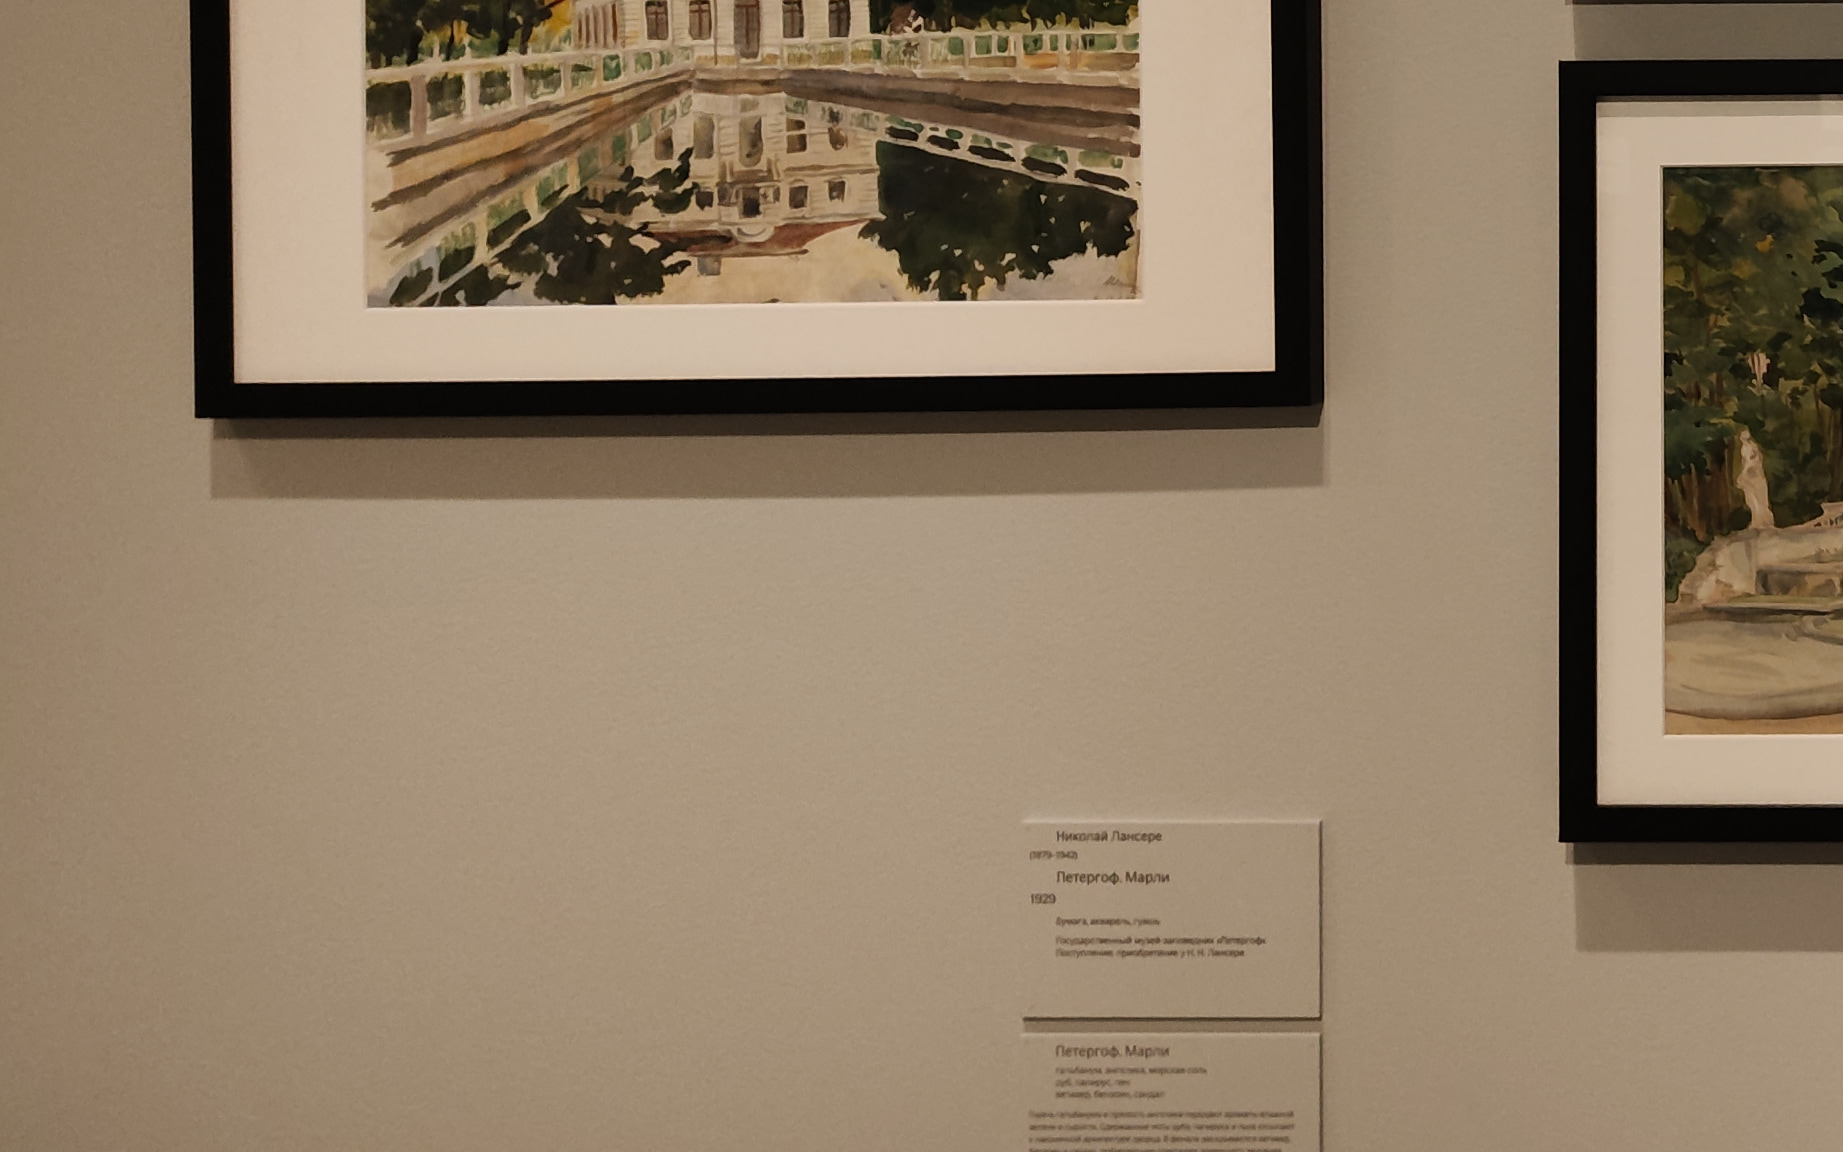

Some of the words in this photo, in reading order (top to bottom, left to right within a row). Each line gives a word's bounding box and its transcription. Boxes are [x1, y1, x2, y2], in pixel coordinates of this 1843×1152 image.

[1056, 830, 1108, 842] Николай
[1111, 830, 1163, 844] Лансере
[1056, 871, 1123, 885] Петергоф.
[1125, 871, 1171, 885] Марли
[1030, 893, 1056, 904] 1929
[1055, 1045, 1122, 1059] Петергоф.
[1125, 1045, 1170, 1059] Марли
